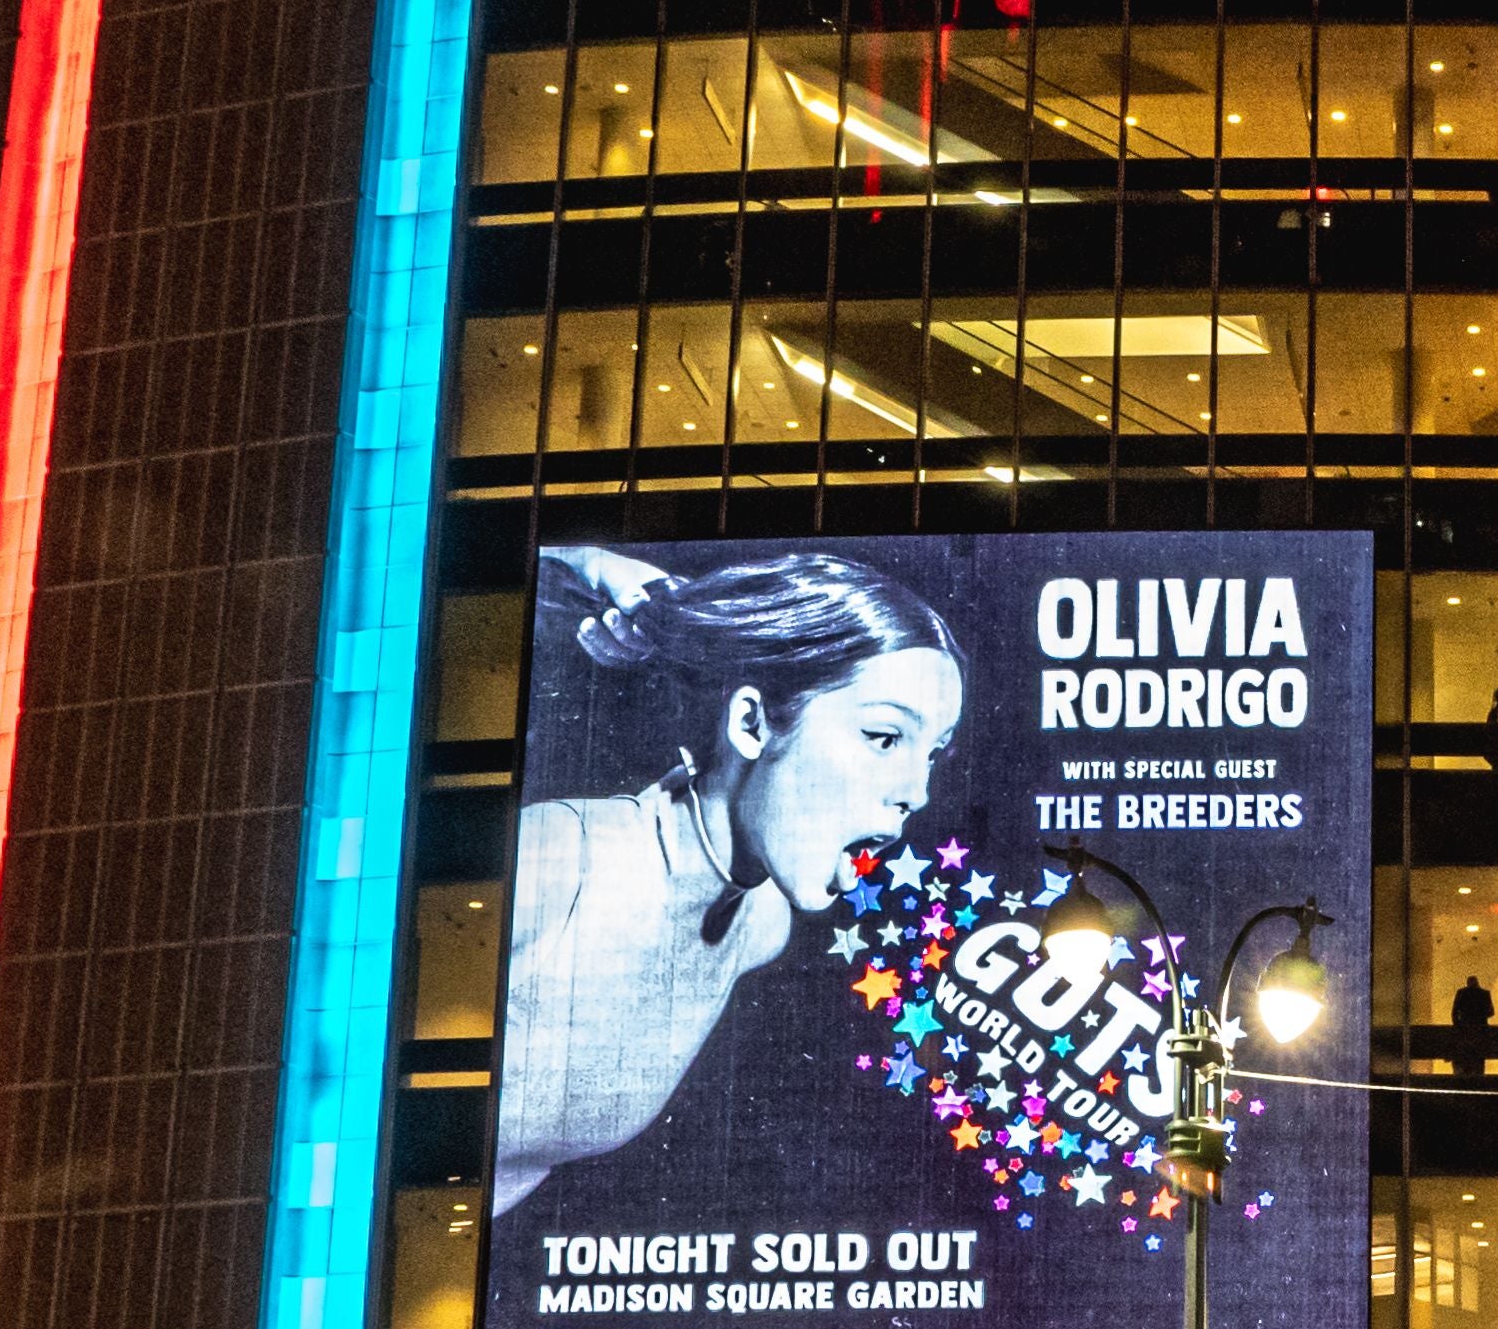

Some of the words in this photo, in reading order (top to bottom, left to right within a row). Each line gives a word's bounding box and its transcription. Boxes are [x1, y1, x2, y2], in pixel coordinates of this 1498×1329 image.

[1037, 577, 1308, 658] OLIVIA
[1041, 668, 1308, 728] RODRIGO
[1062, 760, 1115, 779] WITH
[1124, 760, 1206, 779] SPECIAL
[1215, 759, 1276, 778] GUEST
[1035, 795, 1102, 829] THE
[1118, 793, 1303, 828] BREEDERS
[935, 972, 1046, 1074] WORLD
[1046, 1069, 1141, 1146] TOUR
[543, 1234, 736, 1276] TONIGHT
[752, 1233, 869, 1272] SOLD
[887, 1230, 978, 1271] OUT
[538, 1284, 694, 1313] MADISON
[705, 1281, 834, 1313] SQUARE
[846, 1280, 985, 1310] GARDEN
